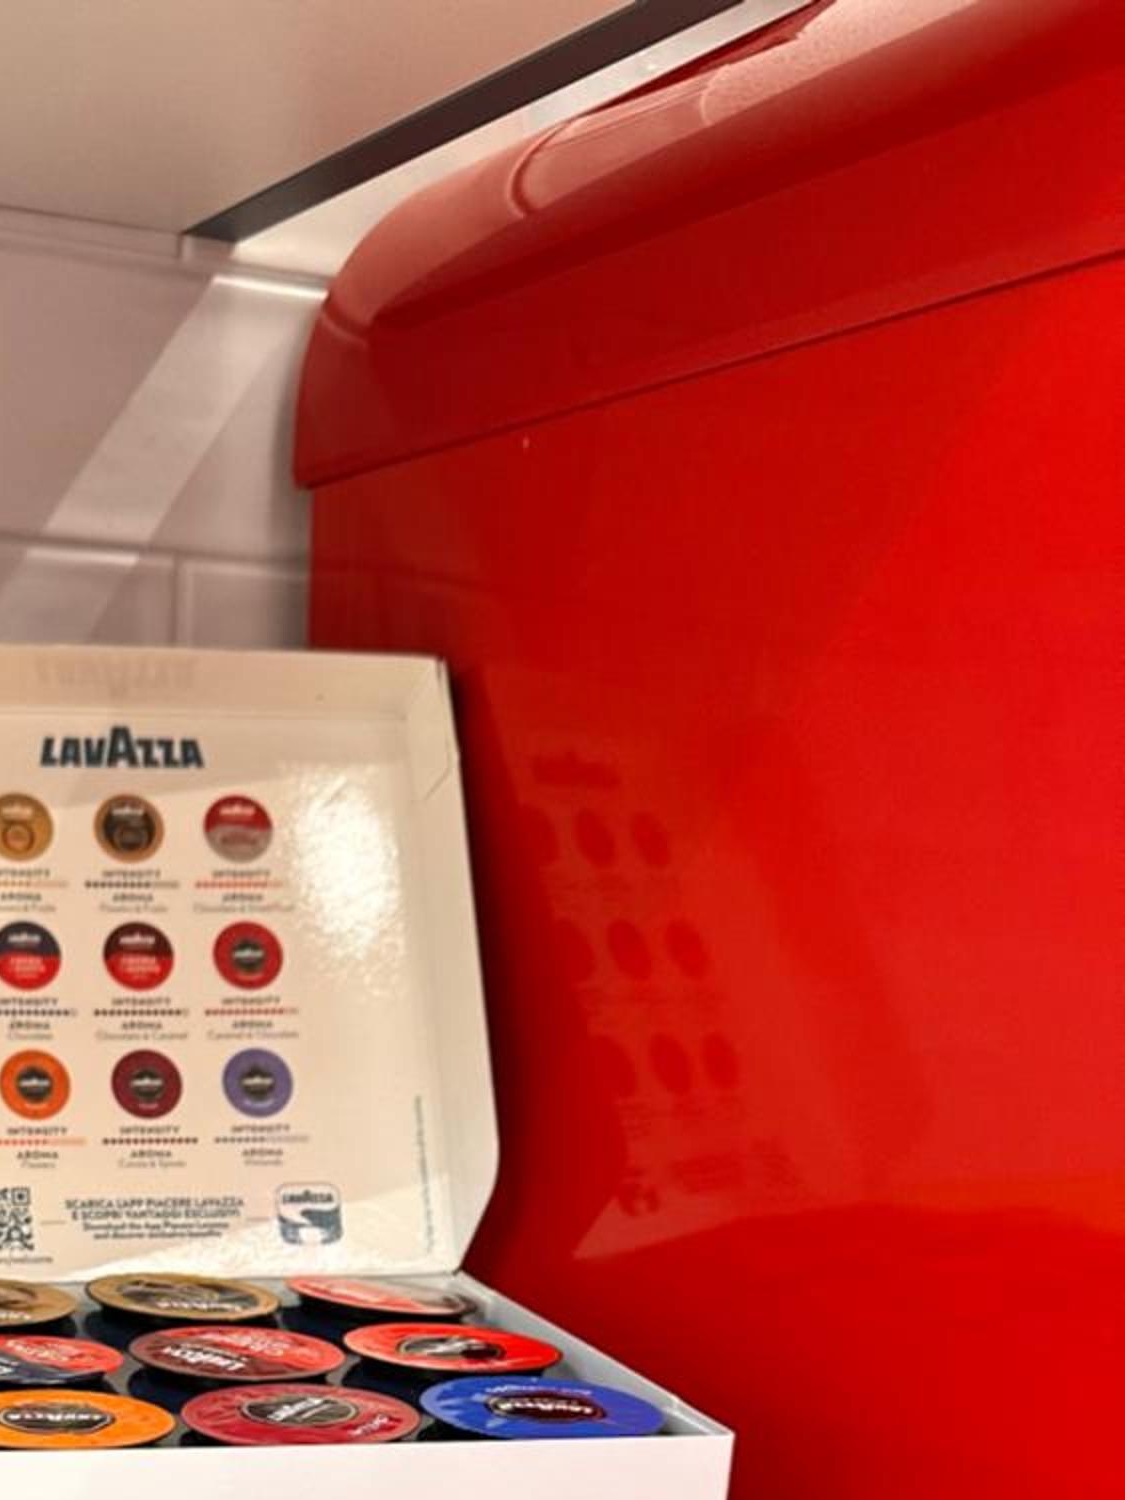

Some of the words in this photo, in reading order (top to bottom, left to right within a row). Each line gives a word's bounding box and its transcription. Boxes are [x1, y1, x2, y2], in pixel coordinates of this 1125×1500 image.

[40, 725, 204, 768] LAVAZZA
[111, 997, 171, 1006] INTENSITY
[221, 996, 281, 1006] INTENSITY
[7, 1126, 68, 1136] INTENSITY
[119, 1125, 180, 1135] INTENSITY
[231, 1124, 291, 1134] INTENSITY
[16, 1151, 59, 1161] AROMA
[130, 1150, 172, 1159] AROMA
[241, 1148, 284, 1158] AROMA
[65, 1199, 114, 1210] SCARICA
[146, 1198, 192, 1208] PIACERE
[193, 1196, 245, 1208] LAVAZZA
[82, 1210, 123, 1220] SCOPRI
